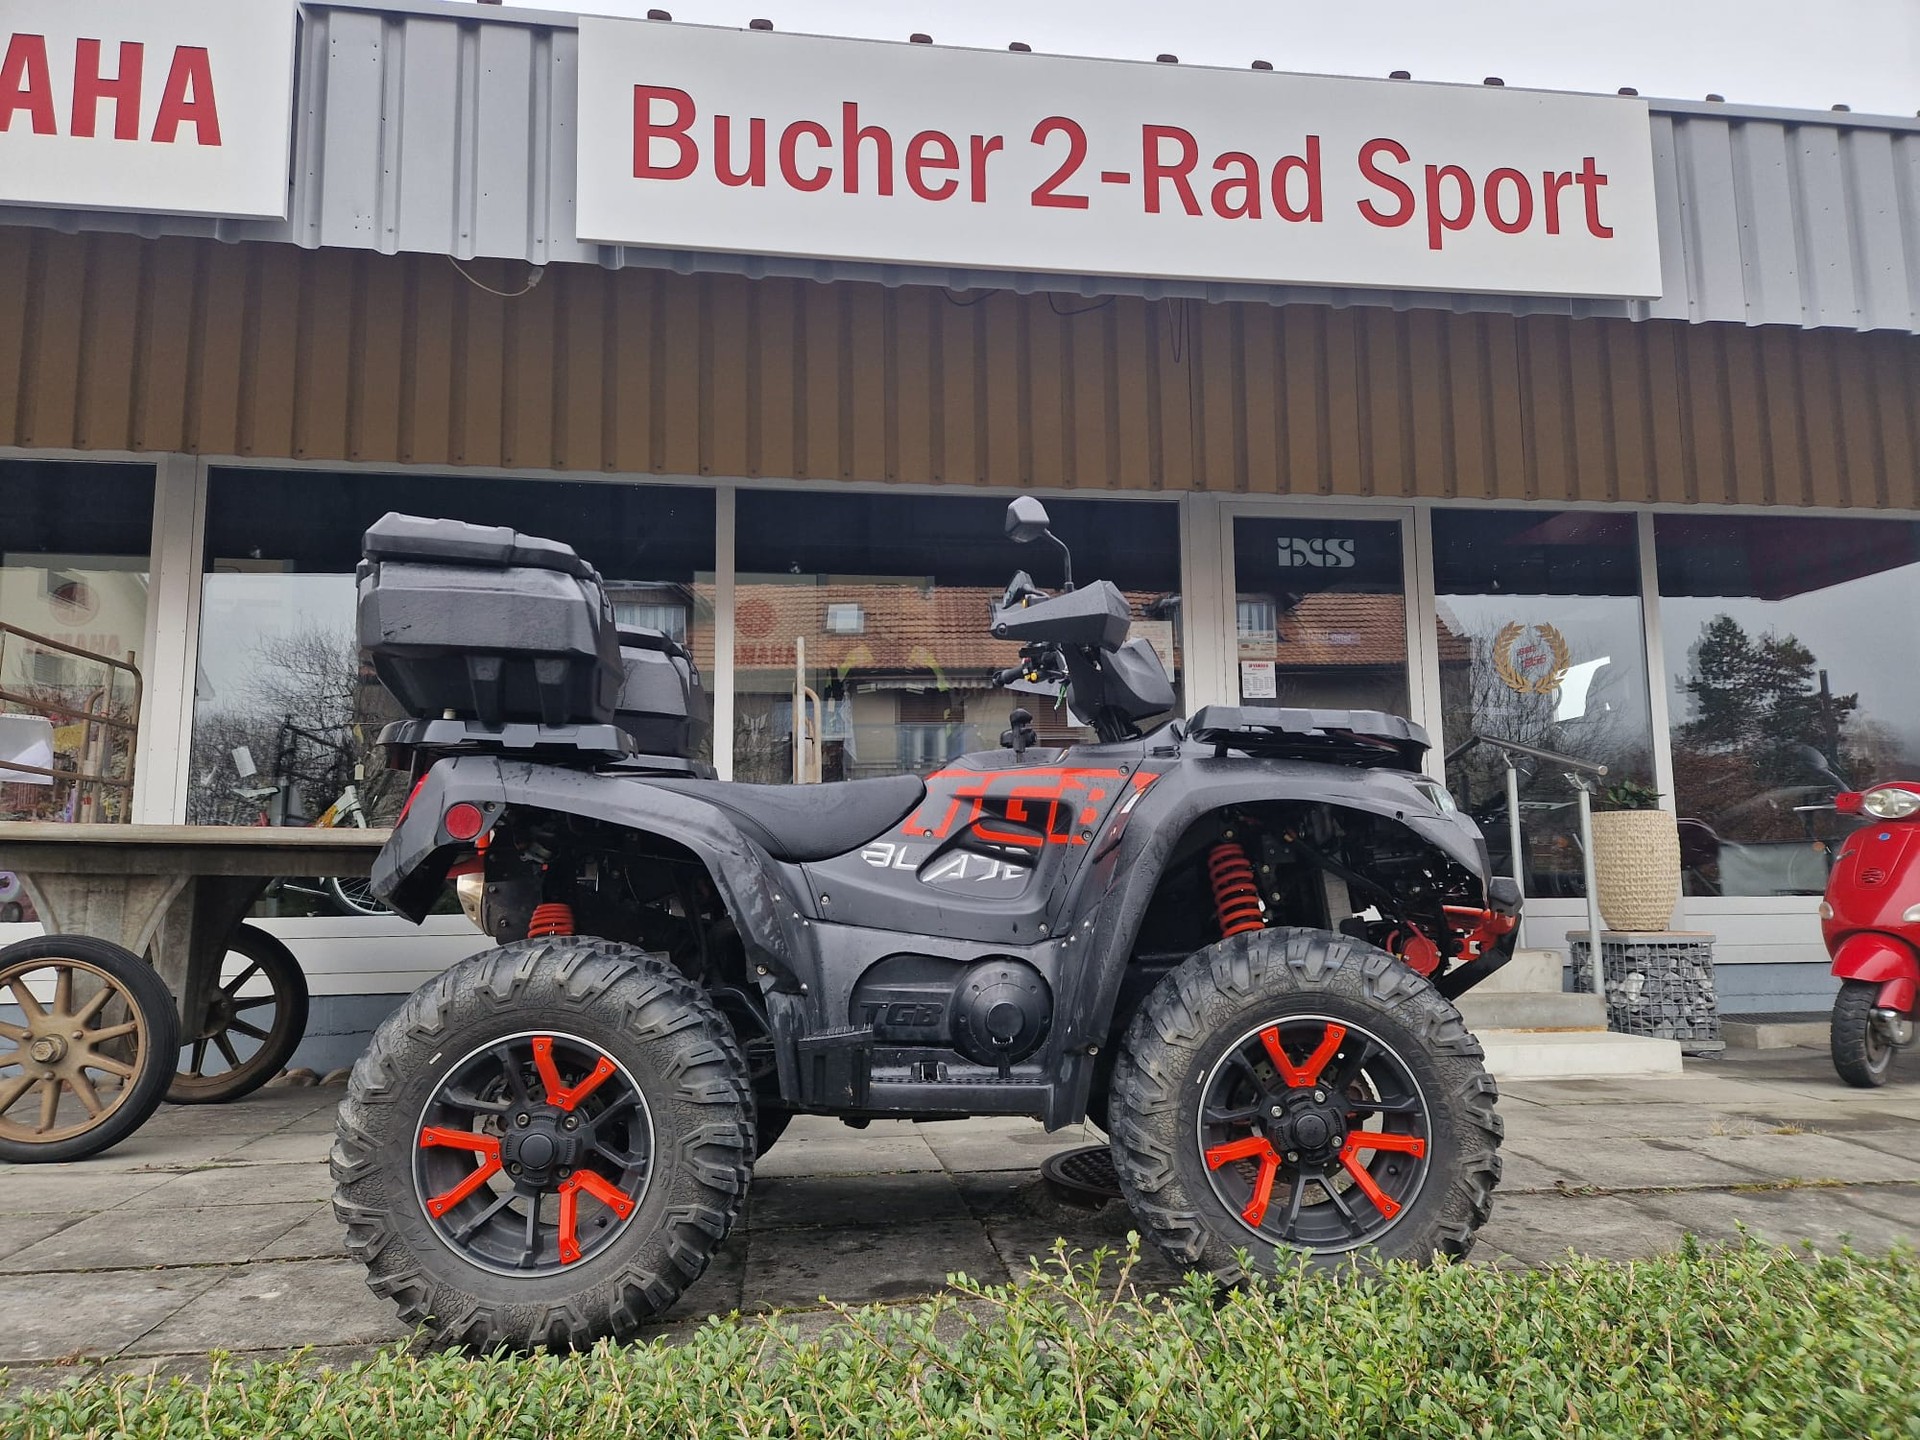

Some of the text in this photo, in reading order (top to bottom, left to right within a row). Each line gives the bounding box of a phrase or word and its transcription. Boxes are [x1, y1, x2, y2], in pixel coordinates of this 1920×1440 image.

[0, 33, 222, 146] AHA
[633, 84, 1614, 251] Bucher 2-Rad Sport
[901, 768, 1125, 847] TGB
[860, 1001, 944, 1027] TGB
